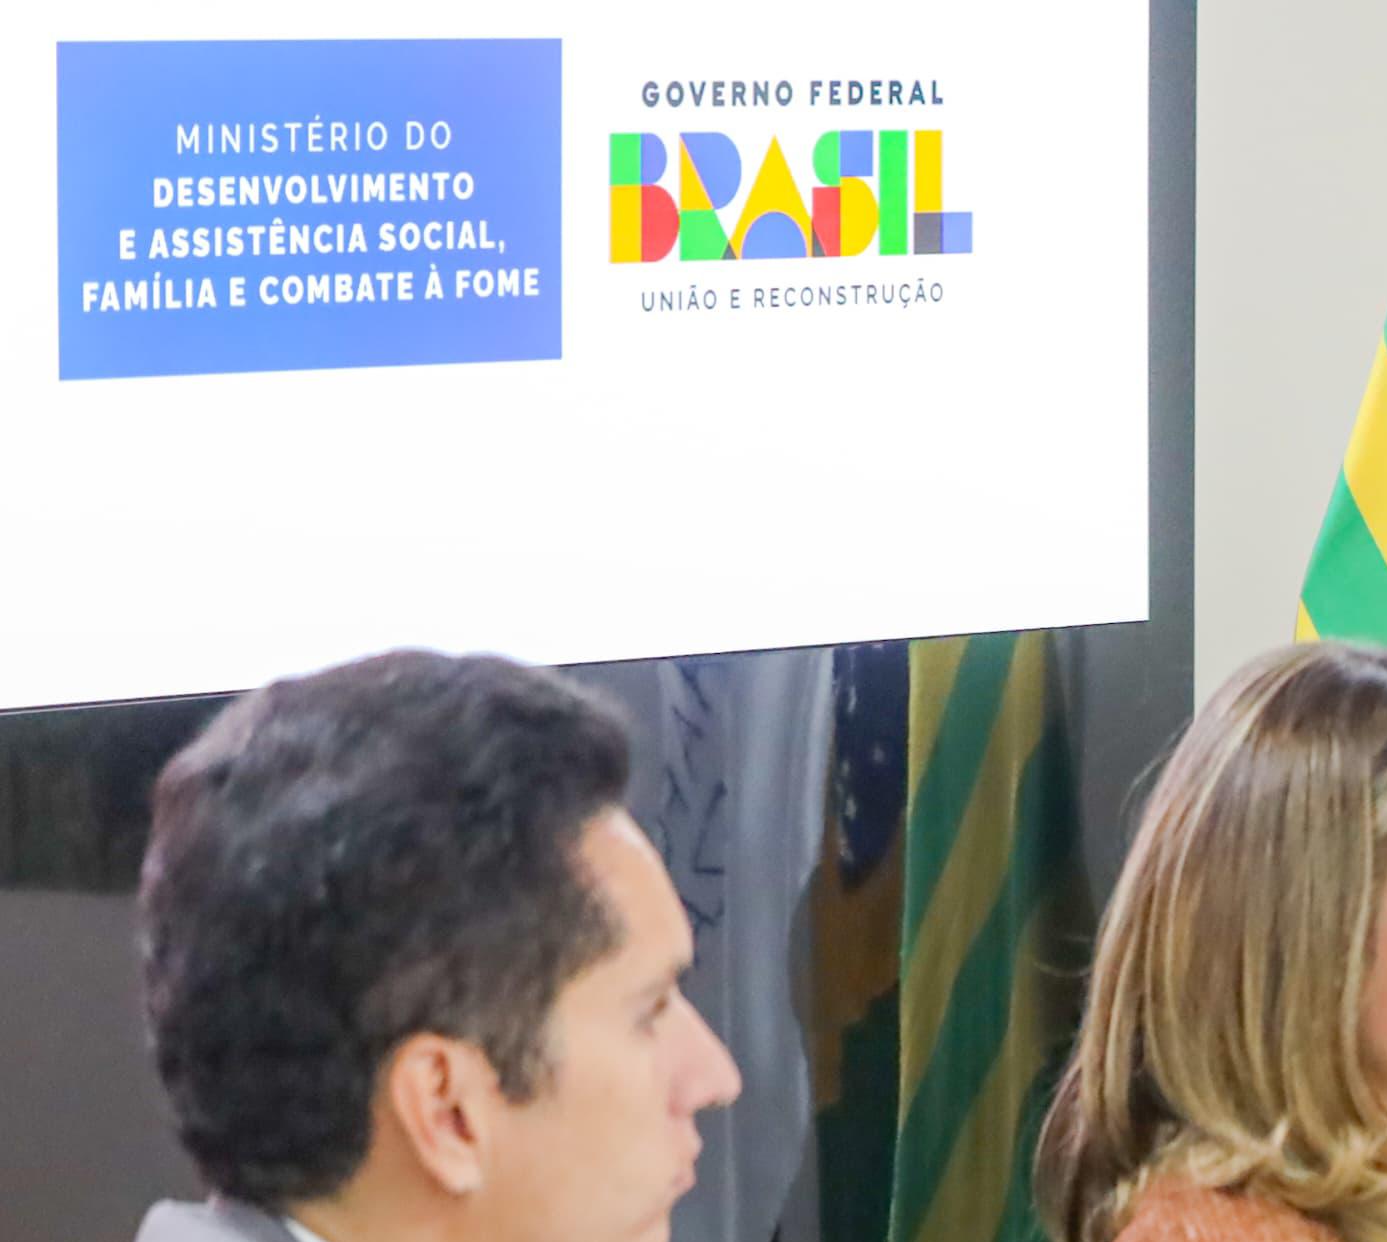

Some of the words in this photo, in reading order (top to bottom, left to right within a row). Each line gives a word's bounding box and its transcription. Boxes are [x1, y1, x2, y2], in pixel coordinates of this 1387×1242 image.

[641, 80, 793, 108] GOVERNO
[810, 79, 944, 106] FEDERAL
[176, 114, 388, 155] MINISTÉRIO
[406, 120, 452, 150] DO
[153, 171, 475, 208] DESENVOLVIMENTO
[609, 129, 973, 264] BRASIL
[119, 229, 136, 260] E
[148, 217, 368, 259] ASSISTÊNCIA
[378, 220, 505, 254] SOCIAL,
[82, 271, 217, 313] FAMÍLIA
[229, 276, 246, 307] E
[259, 271, 414, 305] COMBATE
[424, 262, 444, 300] À
[455, 267, 540, 299] FOME
[641, 284, 717, 313] UNIÃO
[730, 288, 741, 310] E
[753, 277, 944, 309] RECONSTRUÇÃO
